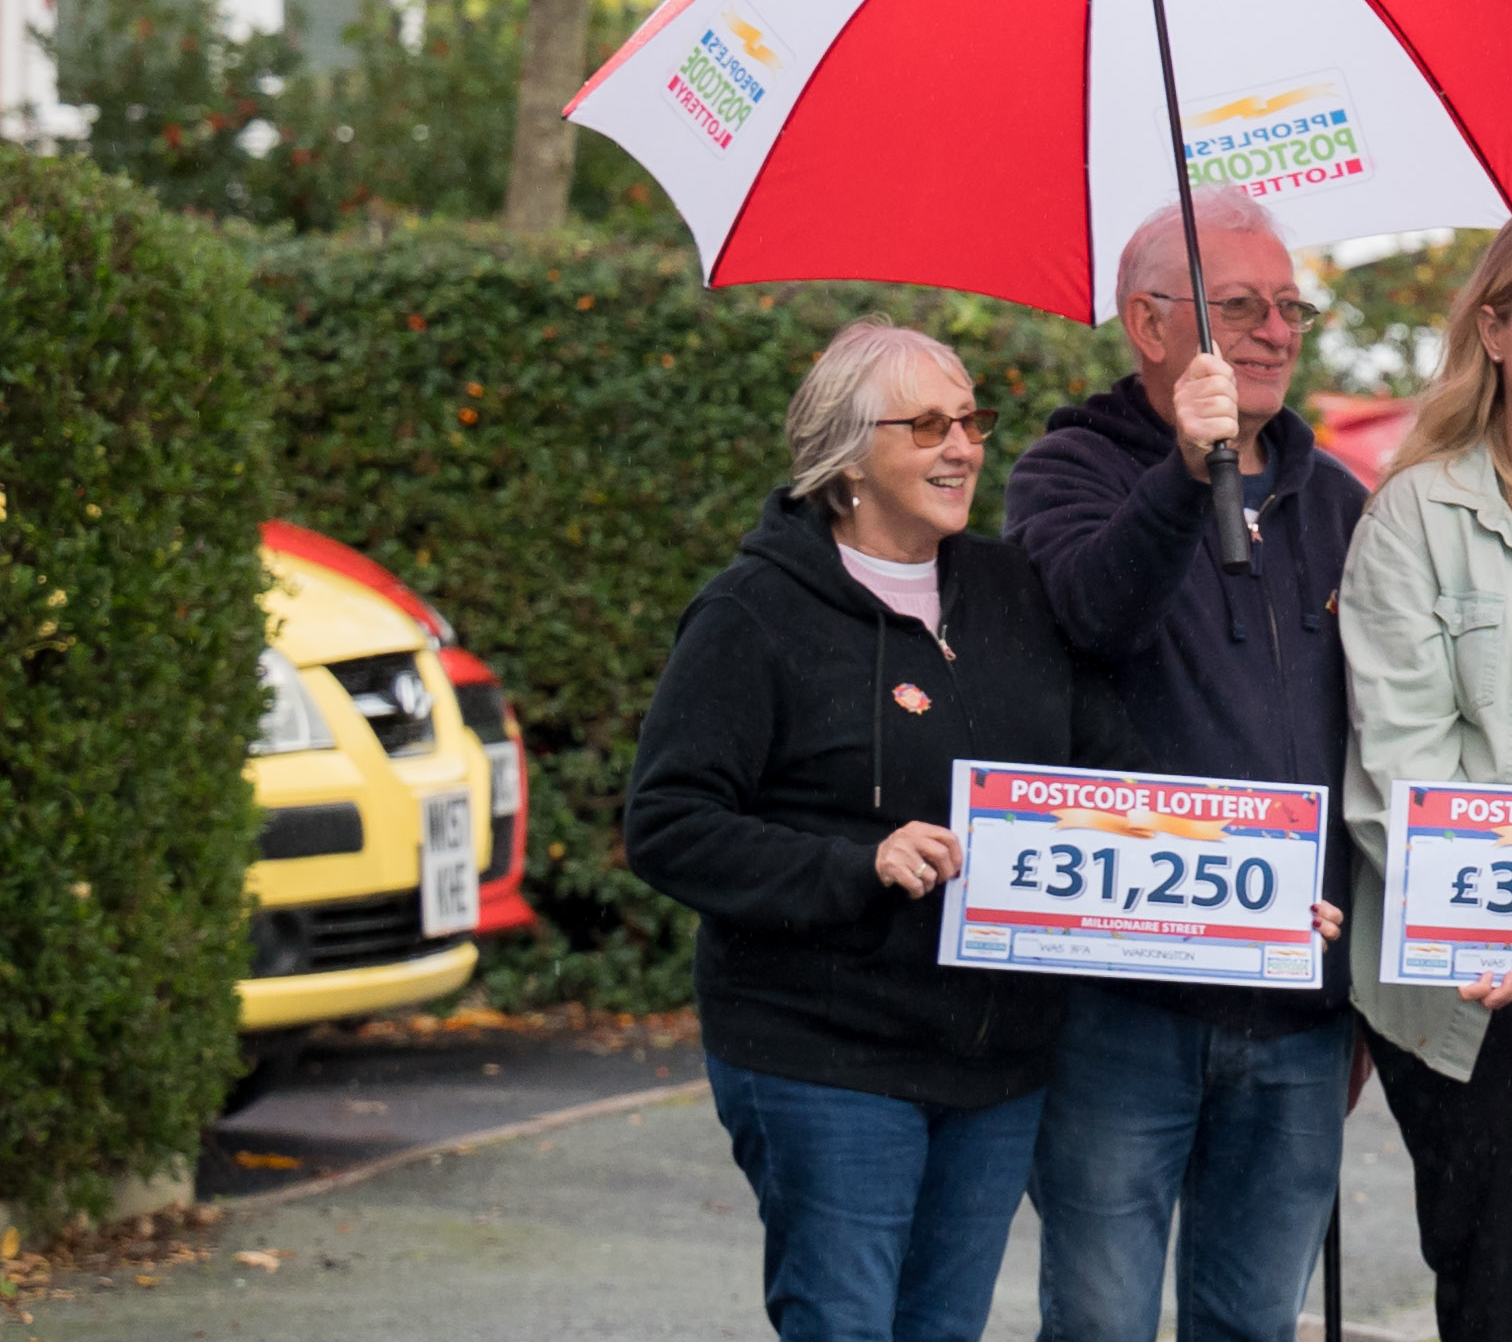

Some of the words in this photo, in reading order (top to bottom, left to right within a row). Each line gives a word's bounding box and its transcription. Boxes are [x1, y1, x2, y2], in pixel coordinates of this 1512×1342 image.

[1011, 780, 1150, 812] POSTCODE
[1157, 792, 1271, 820] LOTTERY
[1010, 844, 1277, 911] £31,250
[1081, 917, 1159, 932] MILLIONAIRE
[1161, 922, 1205, 935] STREET
